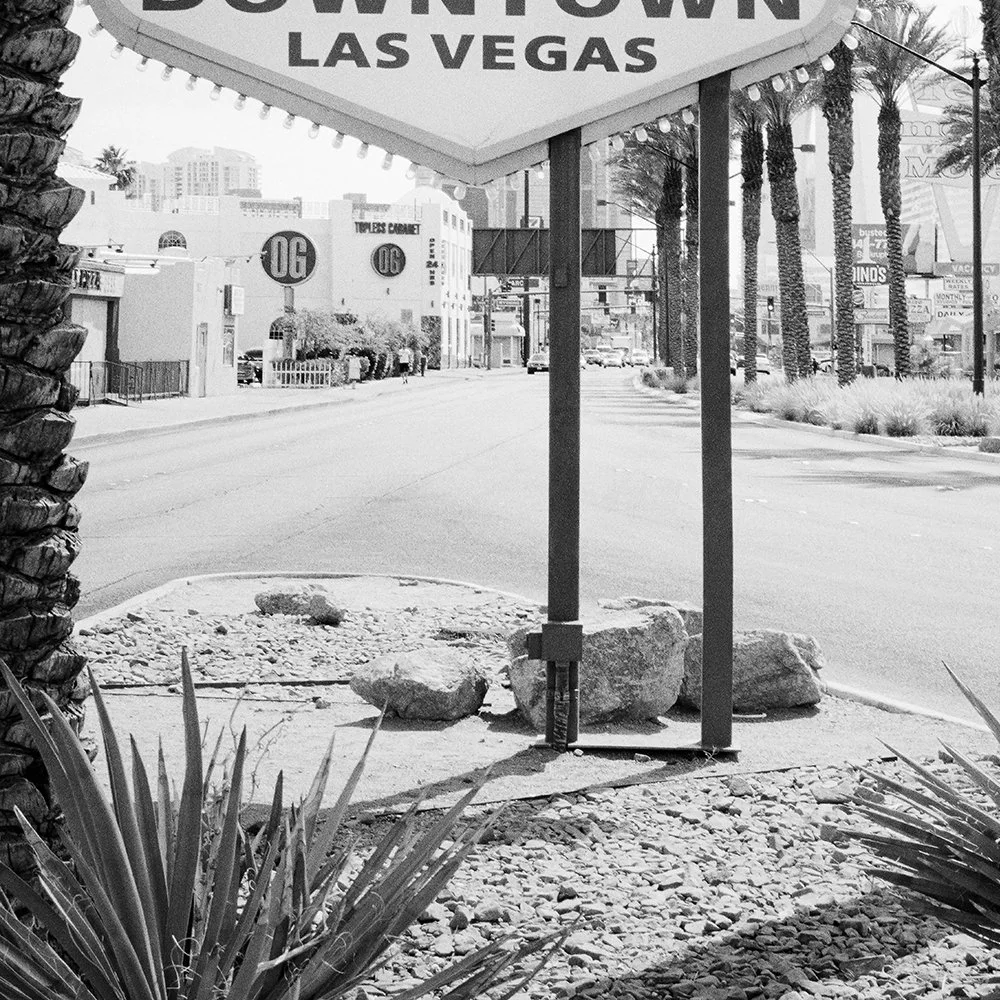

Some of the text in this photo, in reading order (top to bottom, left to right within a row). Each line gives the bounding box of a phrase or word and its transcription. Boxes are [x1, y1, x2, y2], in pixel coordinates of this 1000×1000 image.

[288, 31, 658, 74] LAS VEGAS
[270, 235, 307, 279] OG
[378, 246, 400, 274] OG
[952, 264, 997, 274] VACCY
